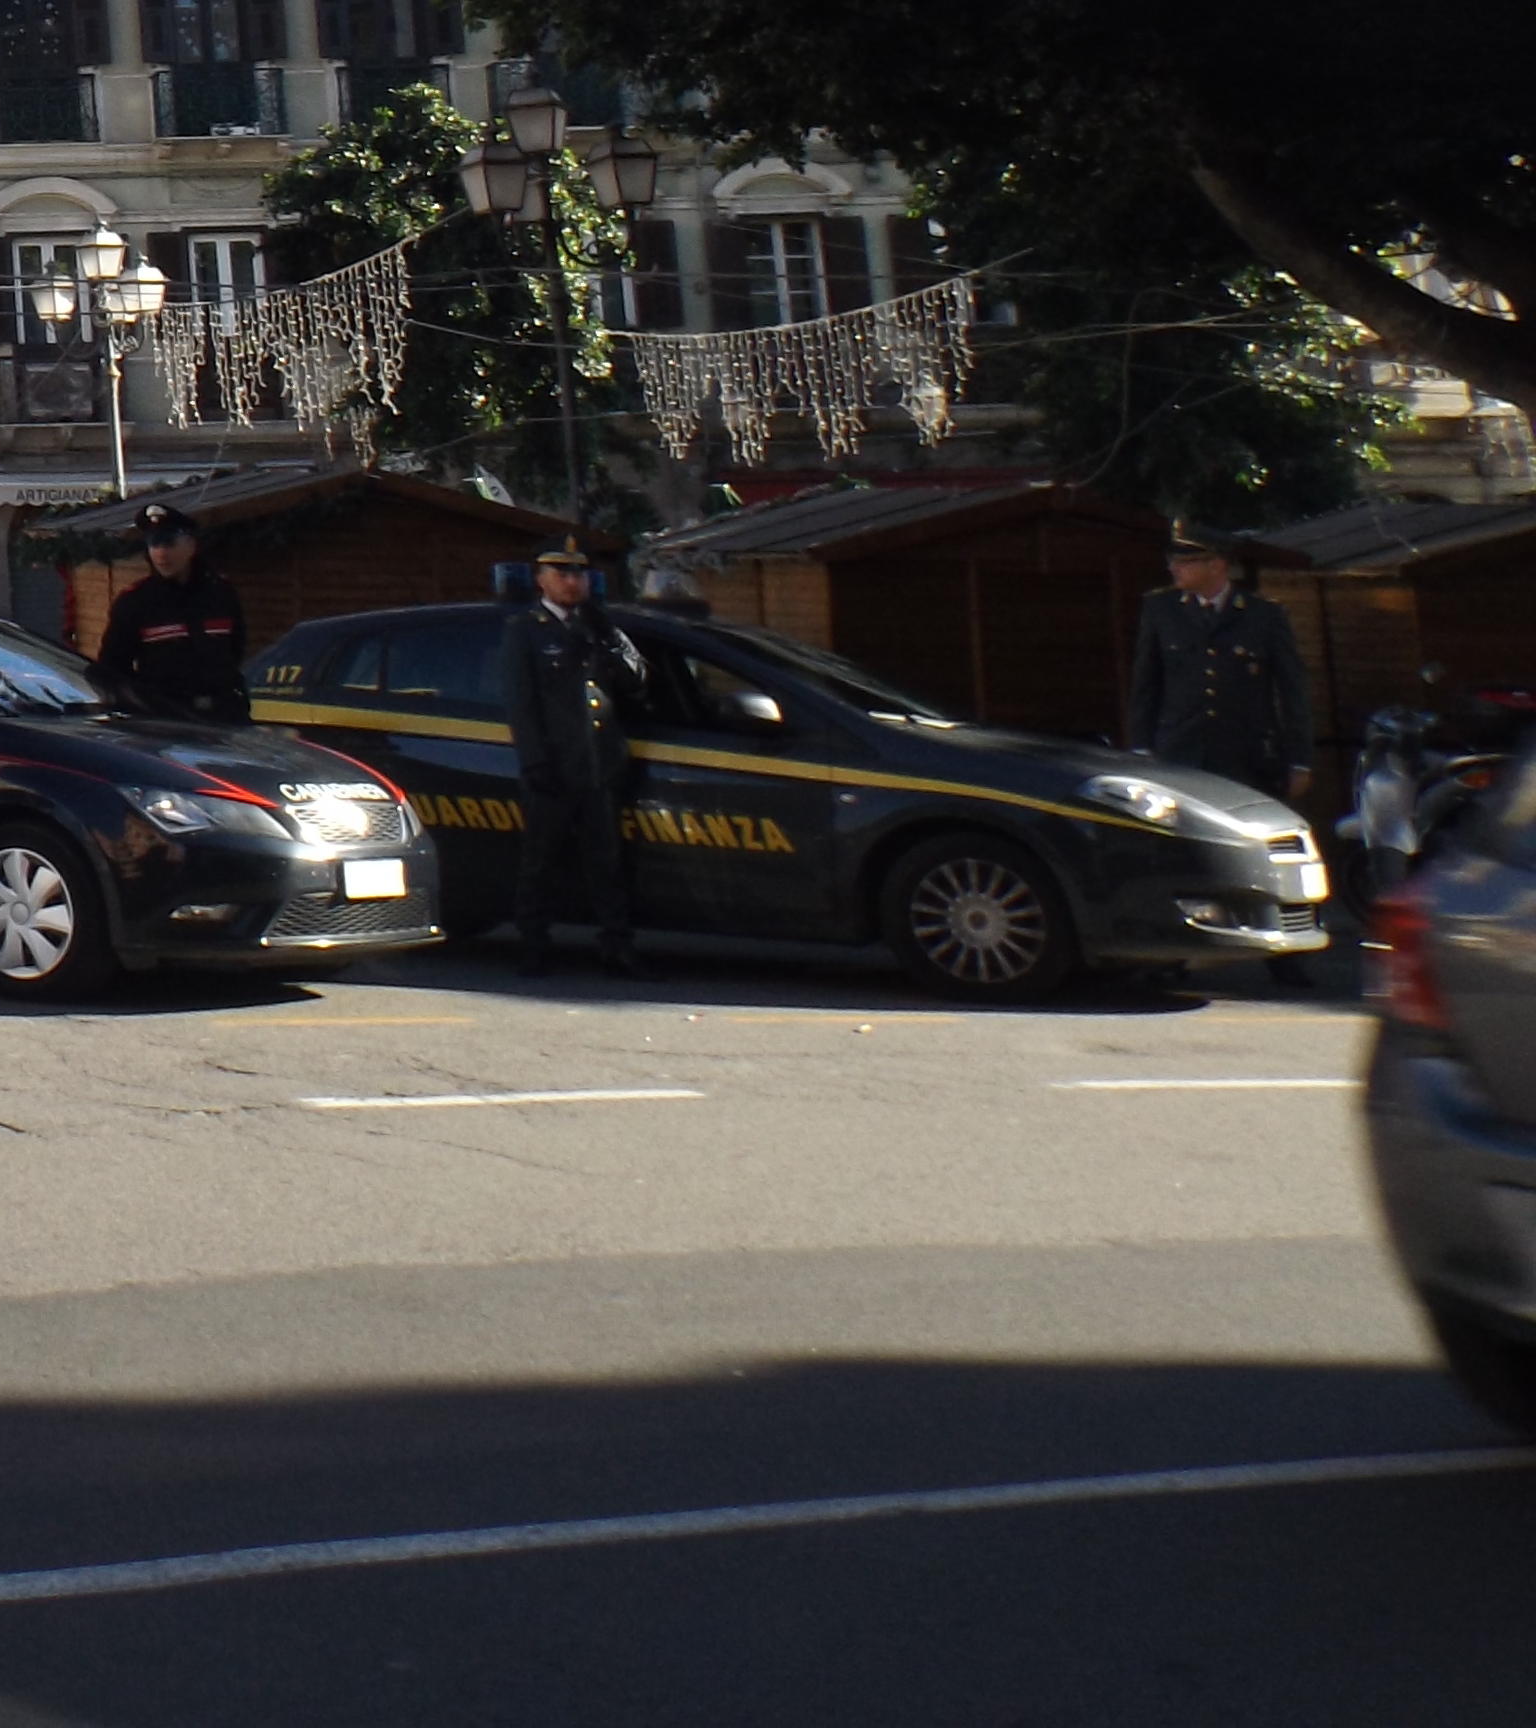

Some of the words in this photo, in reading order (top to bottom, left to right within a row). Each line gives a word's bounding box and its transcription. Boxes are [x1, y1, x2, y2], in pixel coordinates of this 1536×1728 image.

[15, 487, 99, 503] ARTIGIANAT
[266, 664, 304, 684] 117
[408, 792, 526, 832] UARDI
[619, 807, 796, 854] FINANZA
